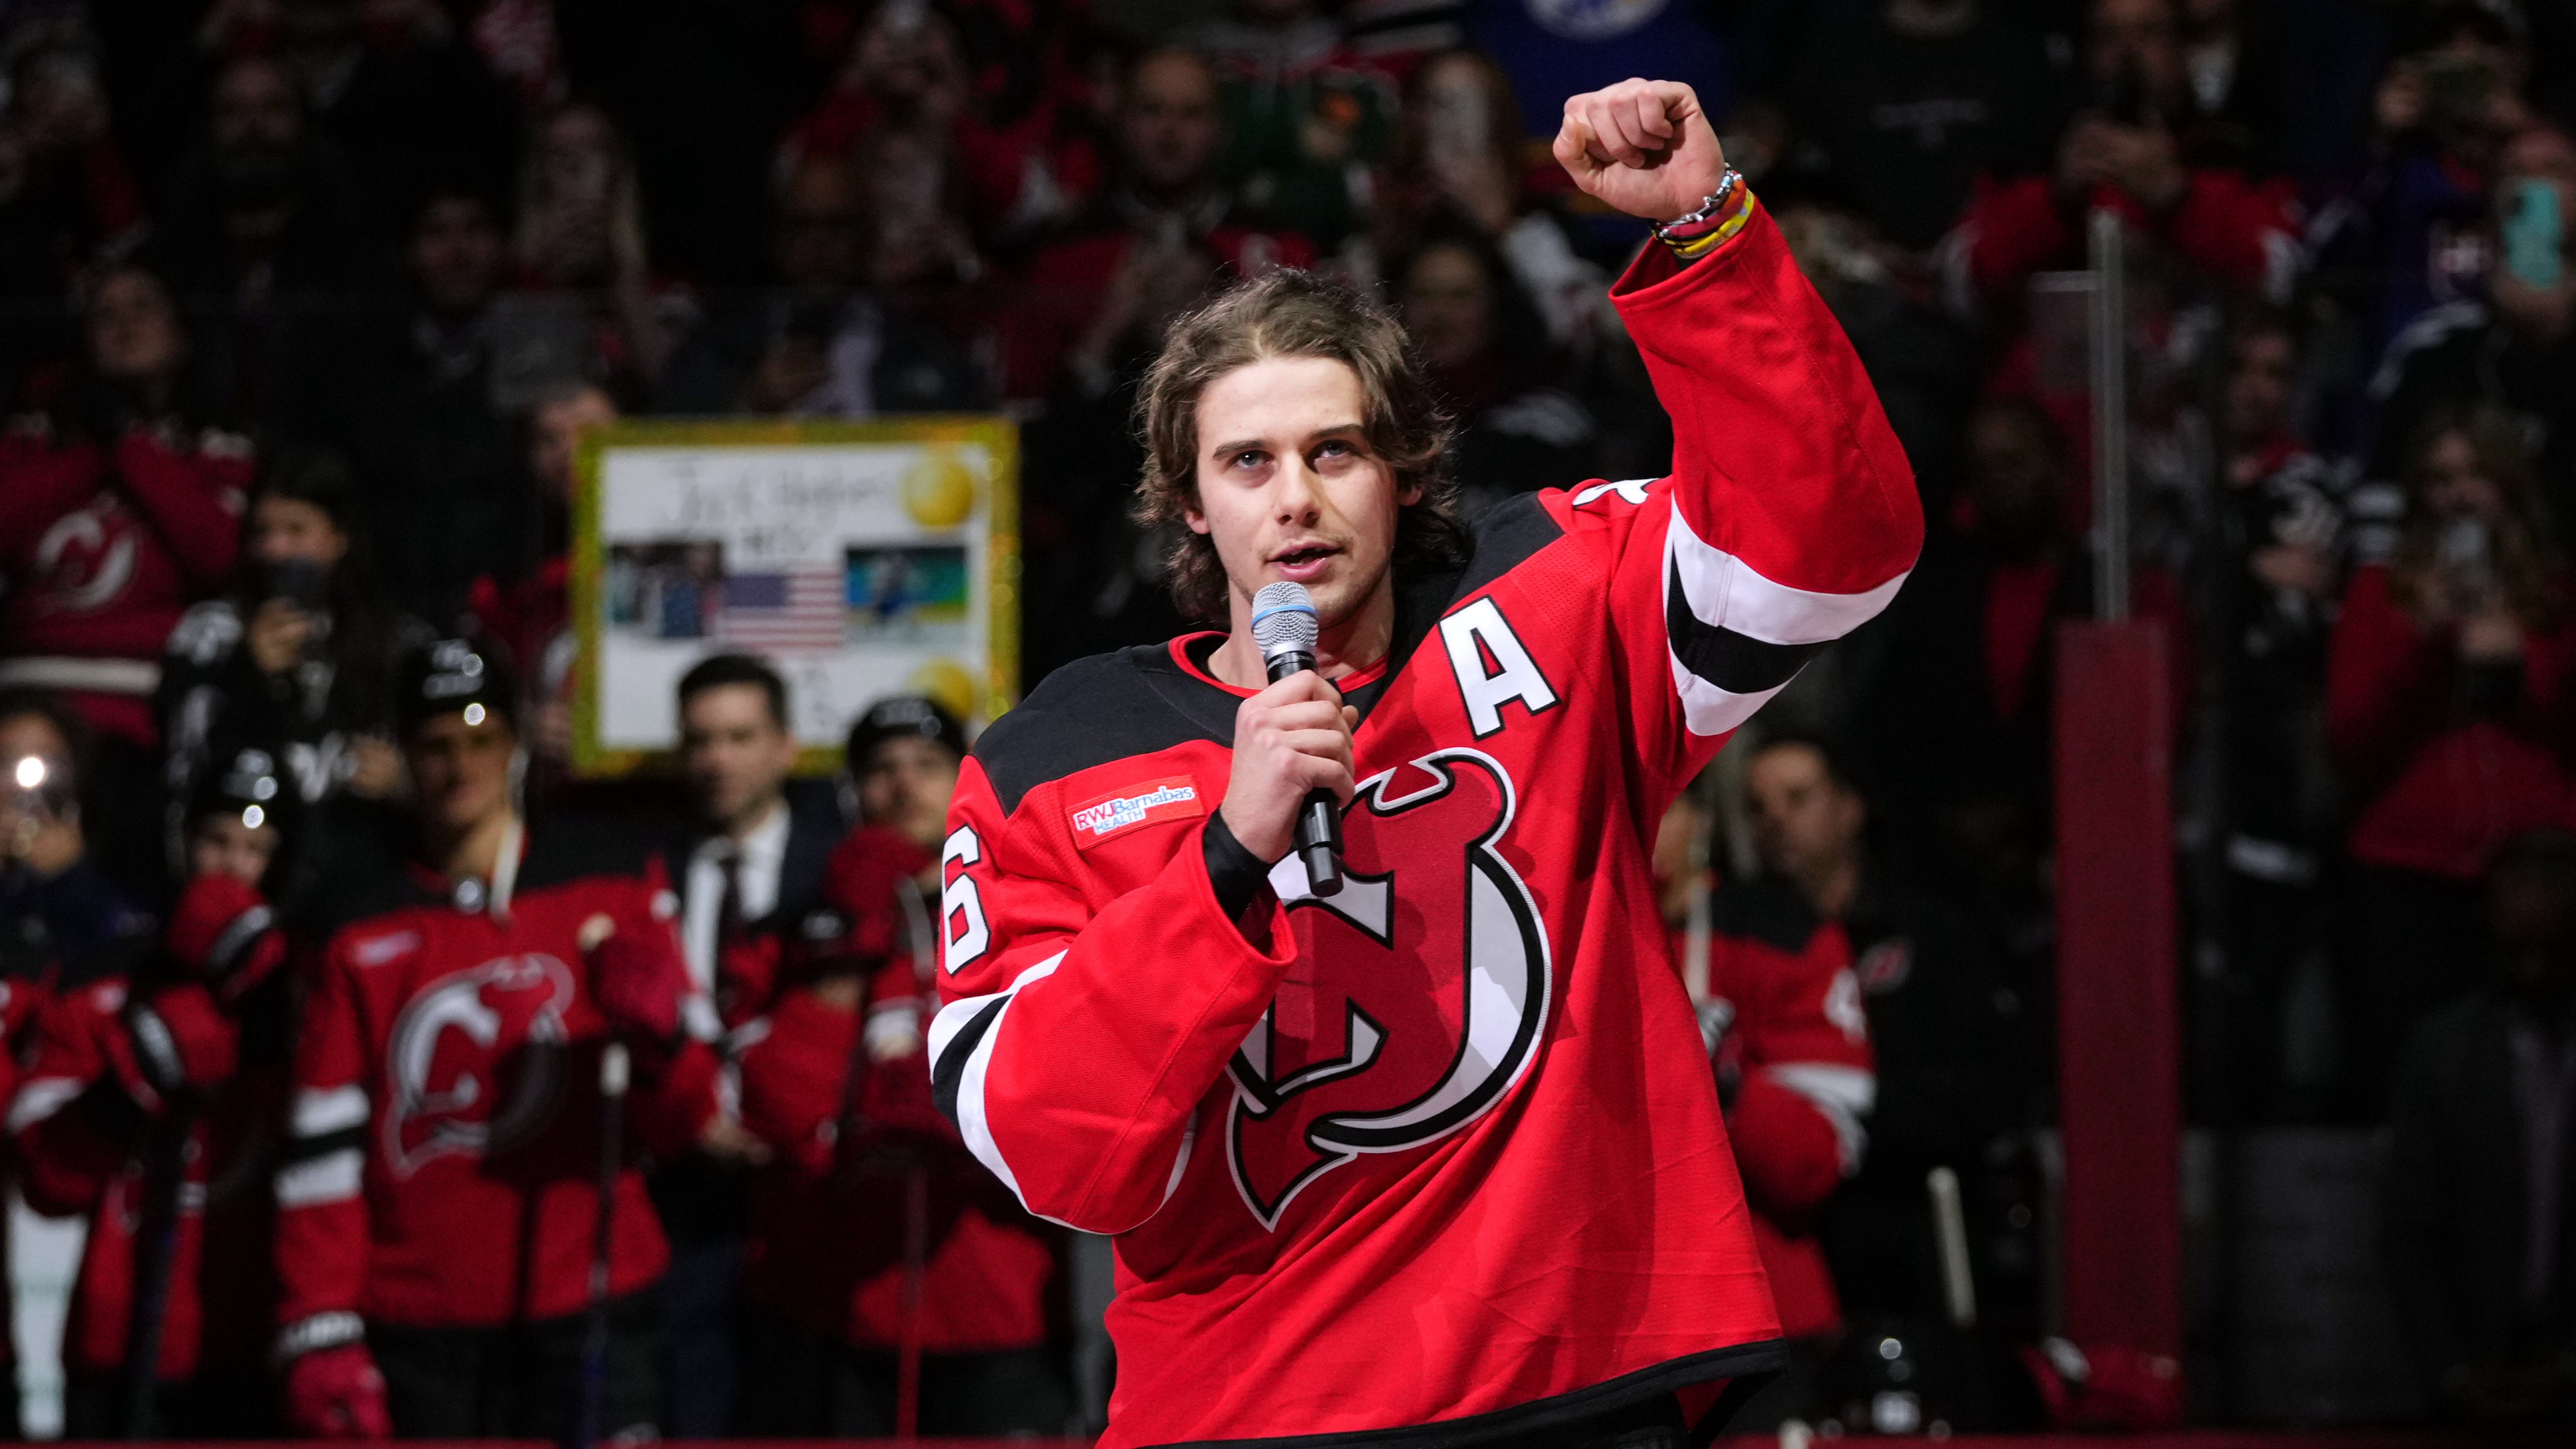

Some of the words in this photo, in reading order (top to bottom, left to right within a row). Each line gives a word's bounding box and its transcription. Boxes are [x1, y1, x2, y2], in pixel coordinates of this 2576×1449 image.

[1437, 594, 1561, 741] A
[1075, 787, 1193, 828] RWJBarnabas
[1096, 808, 1143, 833] HEALTH
[942, 824, 991, 977] 6
